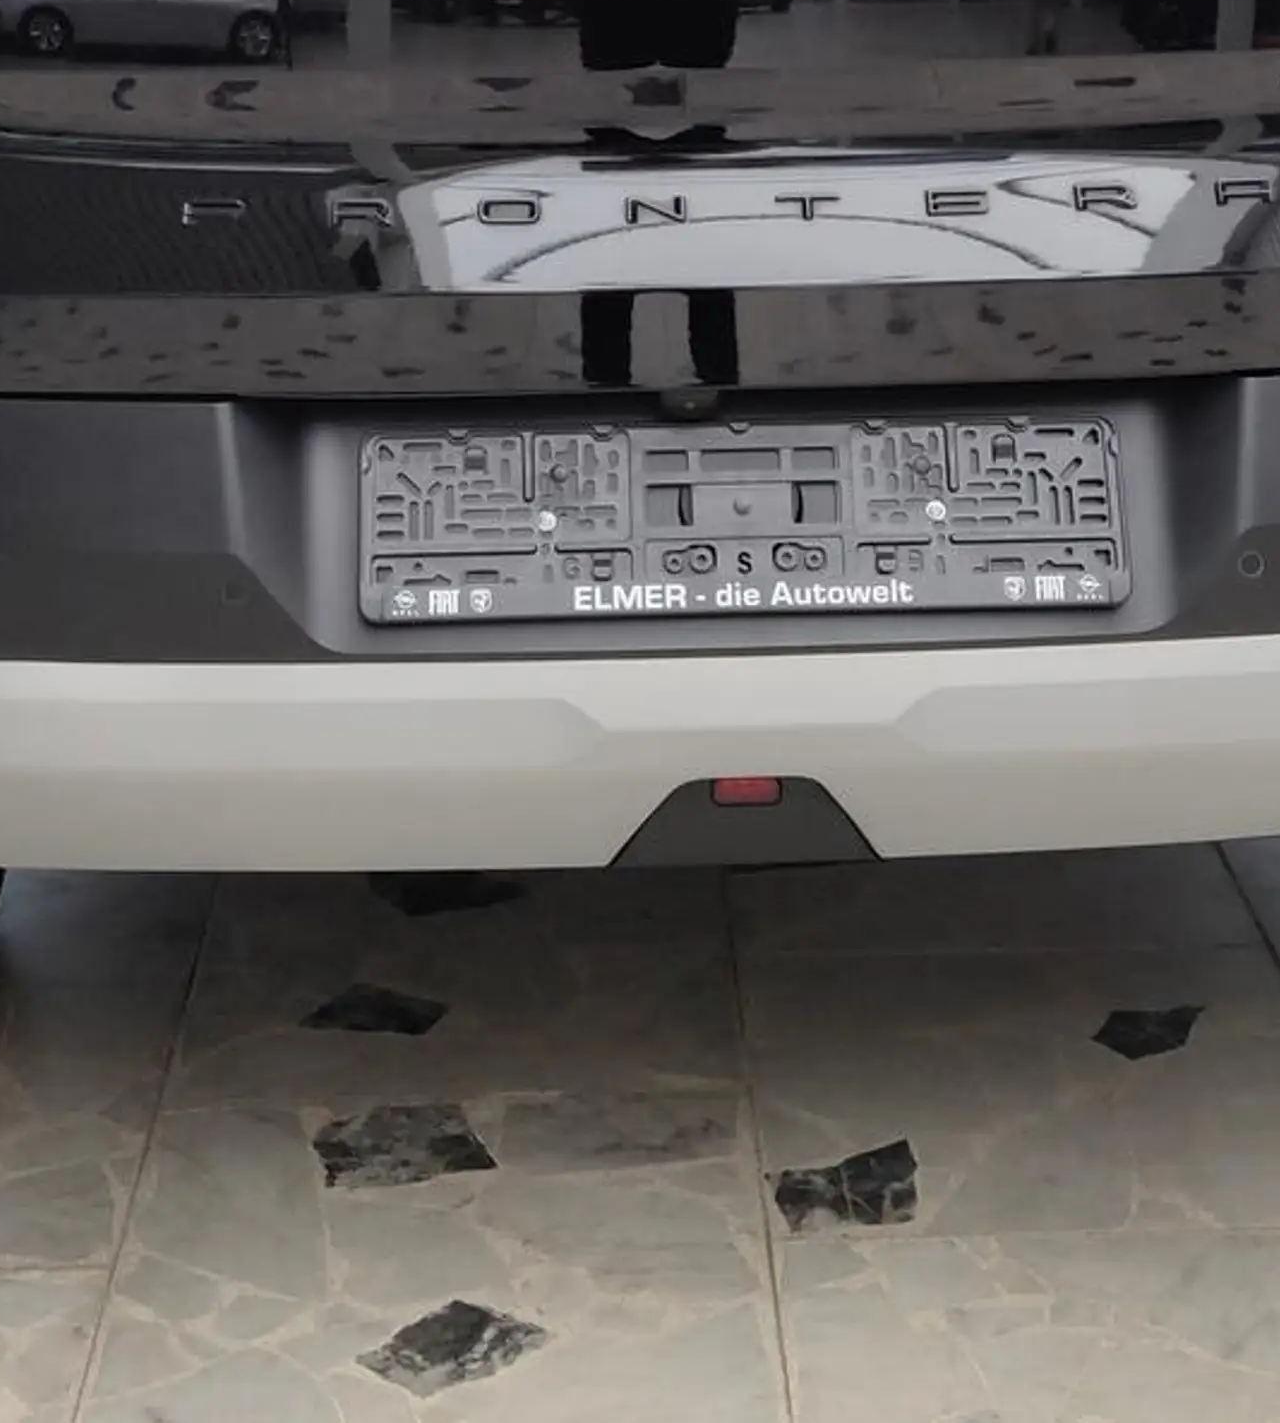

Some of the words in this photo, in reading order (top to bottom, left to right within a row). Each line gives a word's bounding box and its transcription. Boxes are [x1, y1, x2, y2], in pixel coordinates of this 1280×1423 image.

[180, 176, 1276, 229] FRONTERA
[428, 589, 461, 615] FIAT
[573, 583, 687, 611] ELMER
[715, 581, 761, 607] die
[770, 578, 915, 606] Autowelt
